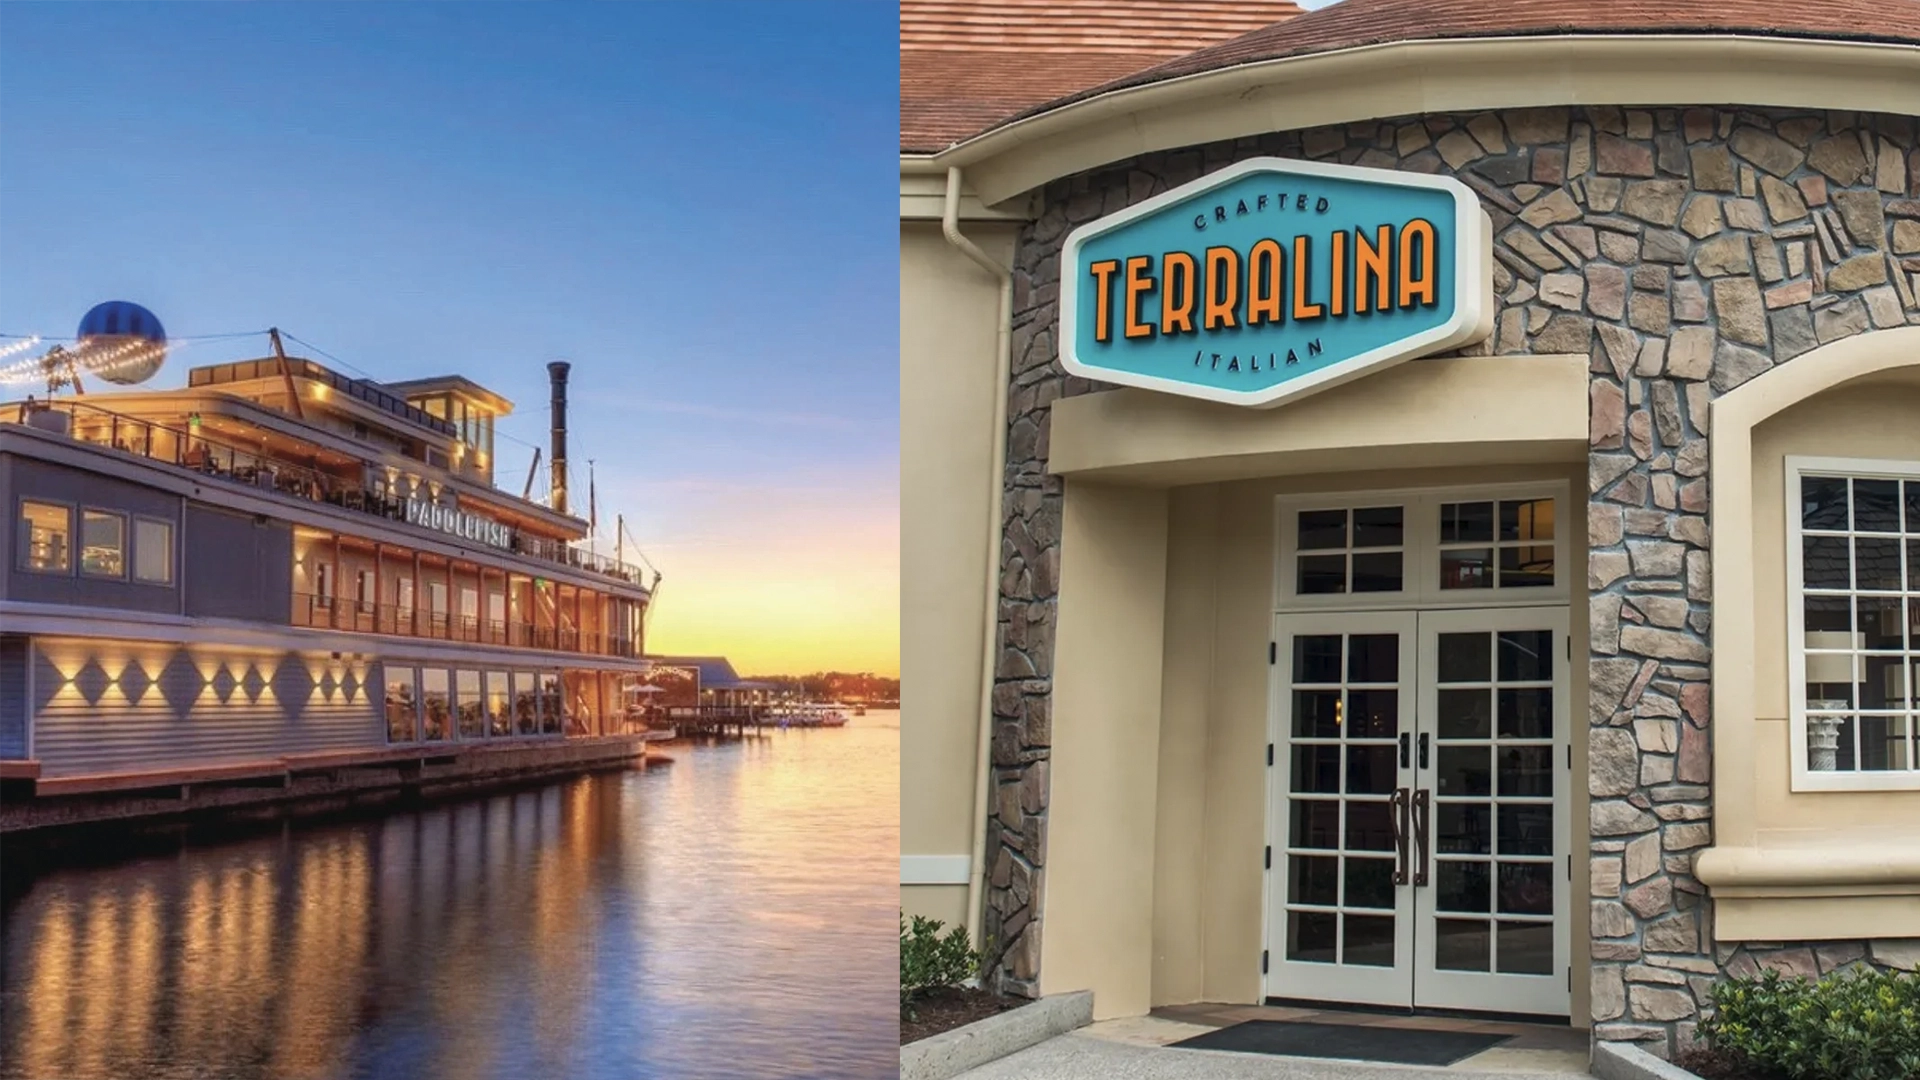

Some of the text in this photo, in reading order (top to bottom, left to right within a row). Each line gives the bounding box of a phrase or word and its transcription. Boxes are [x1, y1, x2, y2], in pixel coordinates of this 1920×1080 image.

[1194, 193, 1330, 229] CRAFTED
[1090, 218, 1438, 342] TERRALINA
[1194, 339, 1324, 372] ITALIAN
[406, 498, 509, 548] PADDLEFISH
